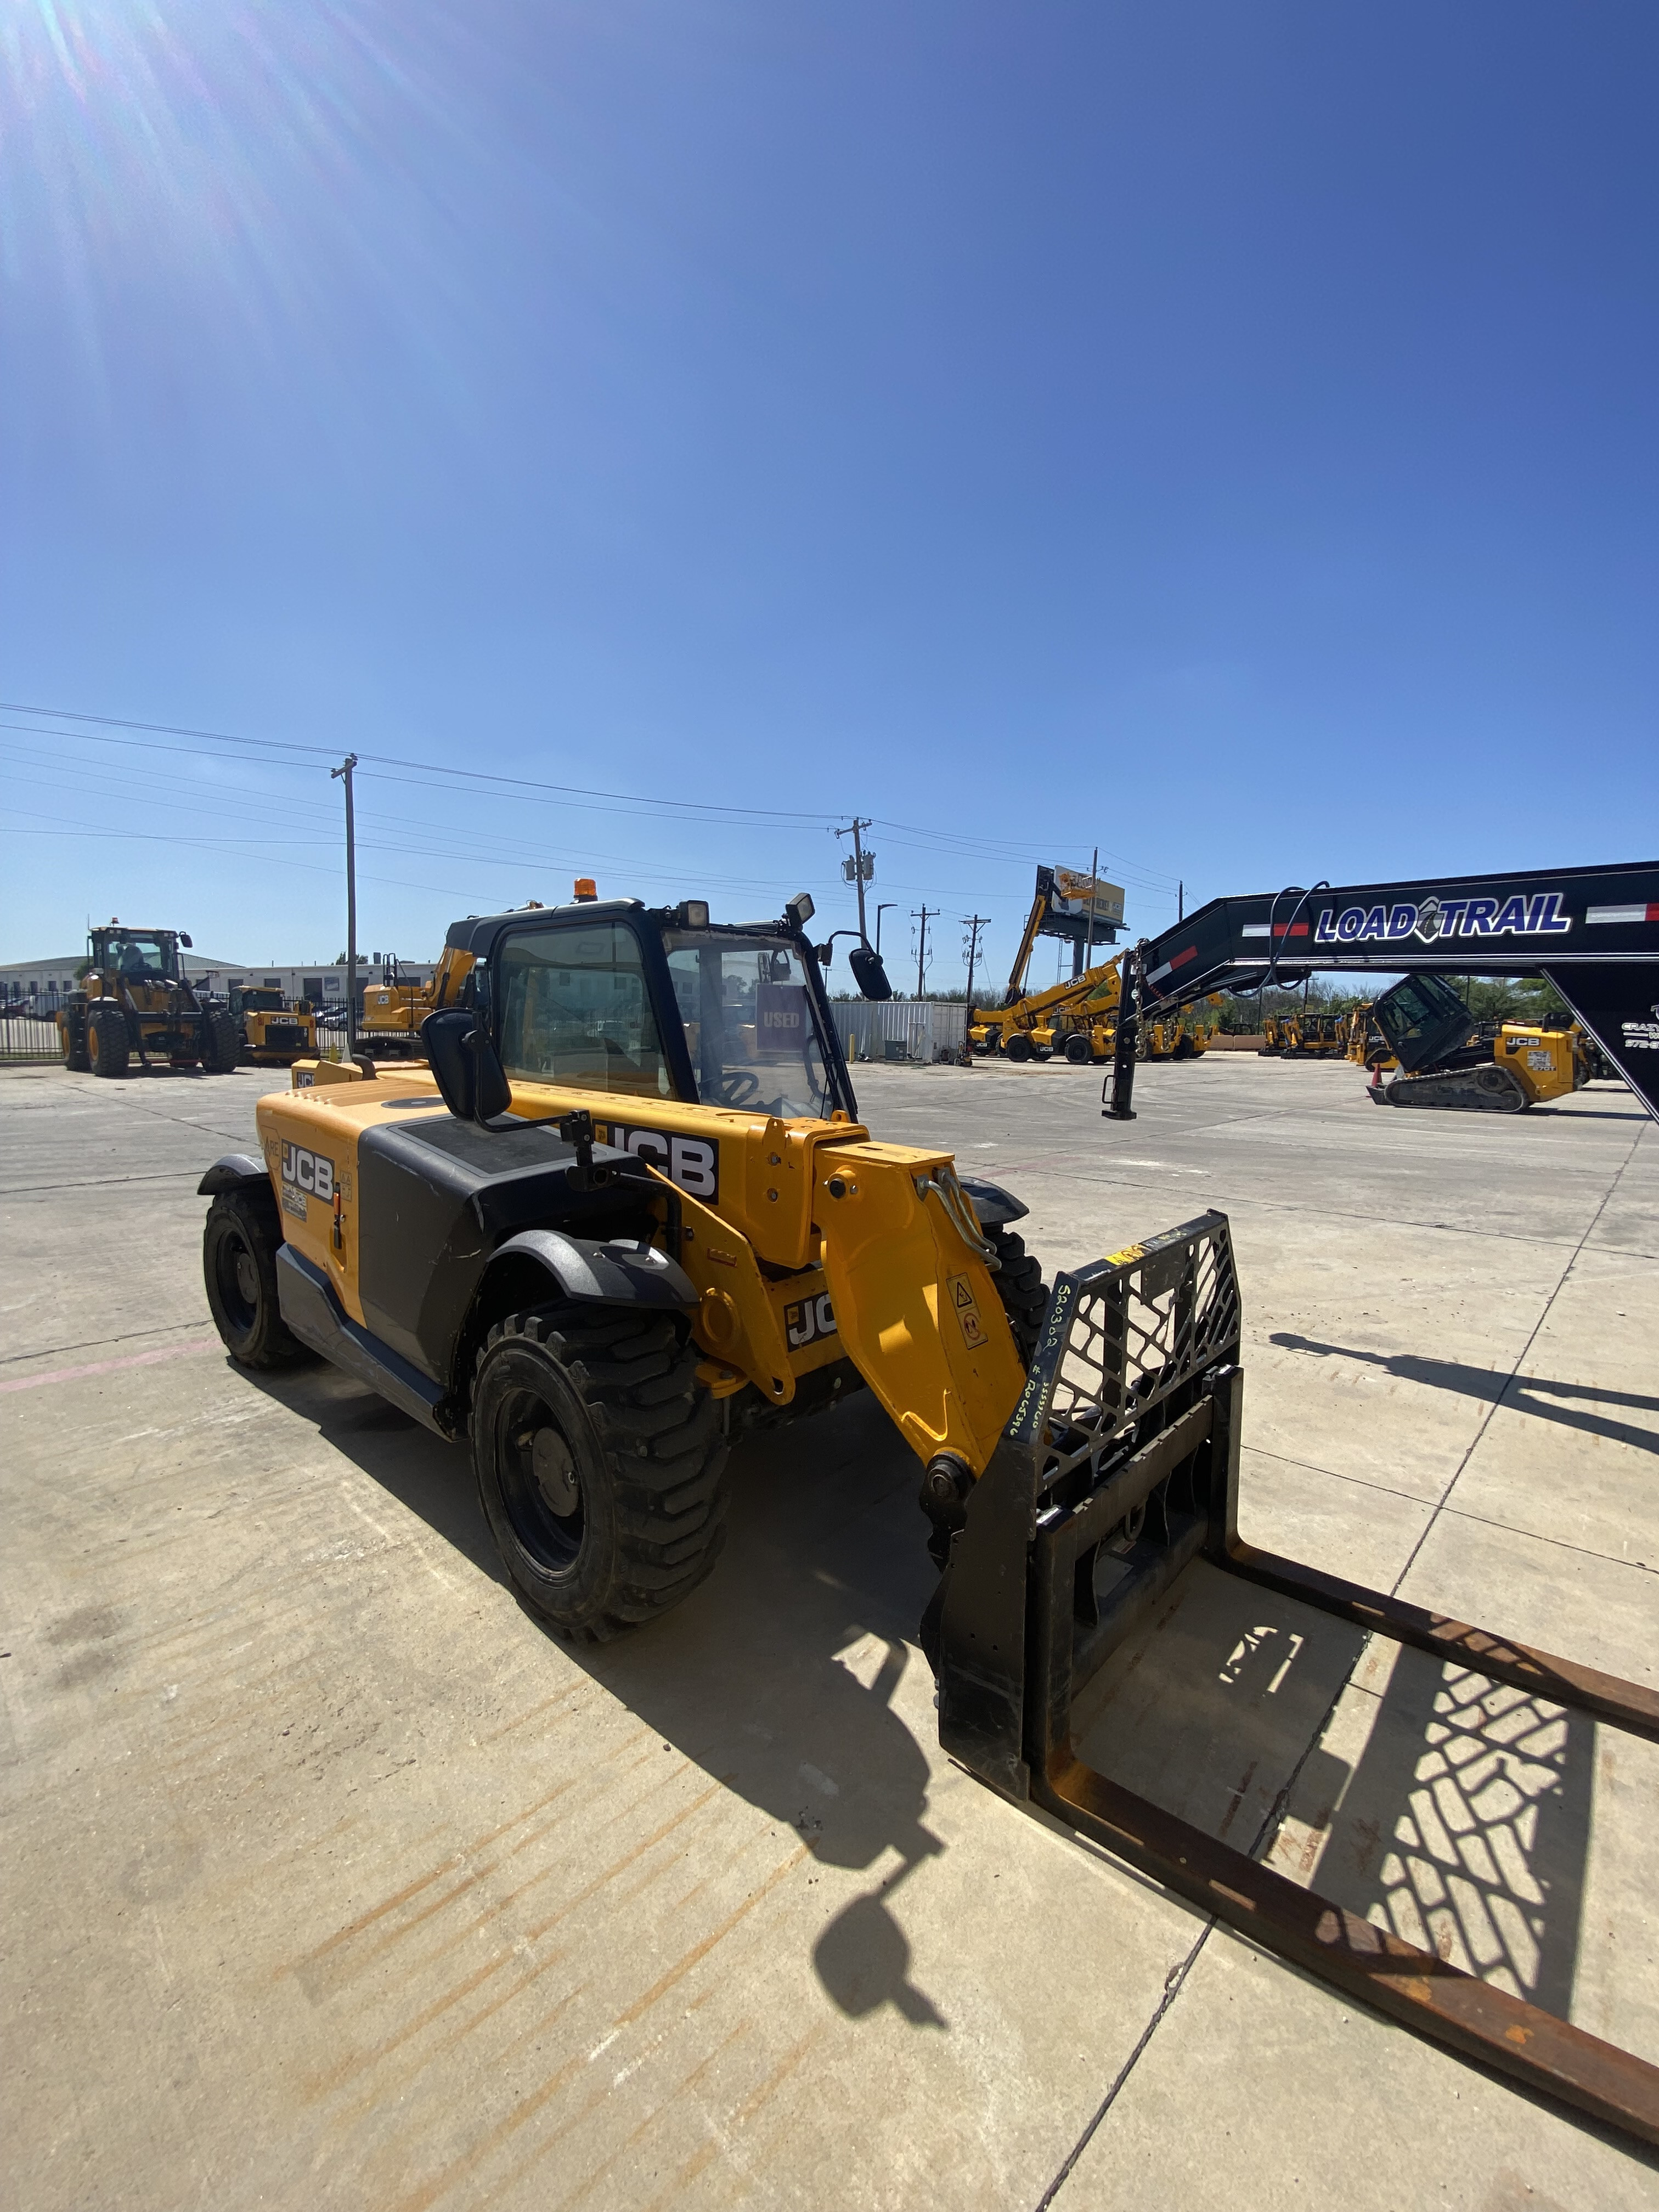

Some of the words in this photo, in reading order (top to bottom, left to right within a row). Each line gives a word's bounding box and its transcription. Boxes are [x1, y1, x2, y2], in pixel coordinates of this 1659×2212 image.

[1314, 904, 1420, 943] LOAD
[1436, 892, 1572, 937] TRAIL
[1065, 975, 1086, 990] JCB
[377, 995, 389, 1005] JCB
[763, 1012, 799, 1028] USED
[1506, 1037, 1540, 1046] JCB
[283, 1146, 334, 1200] JCB
[789, 1293, 837, 1345] JC
